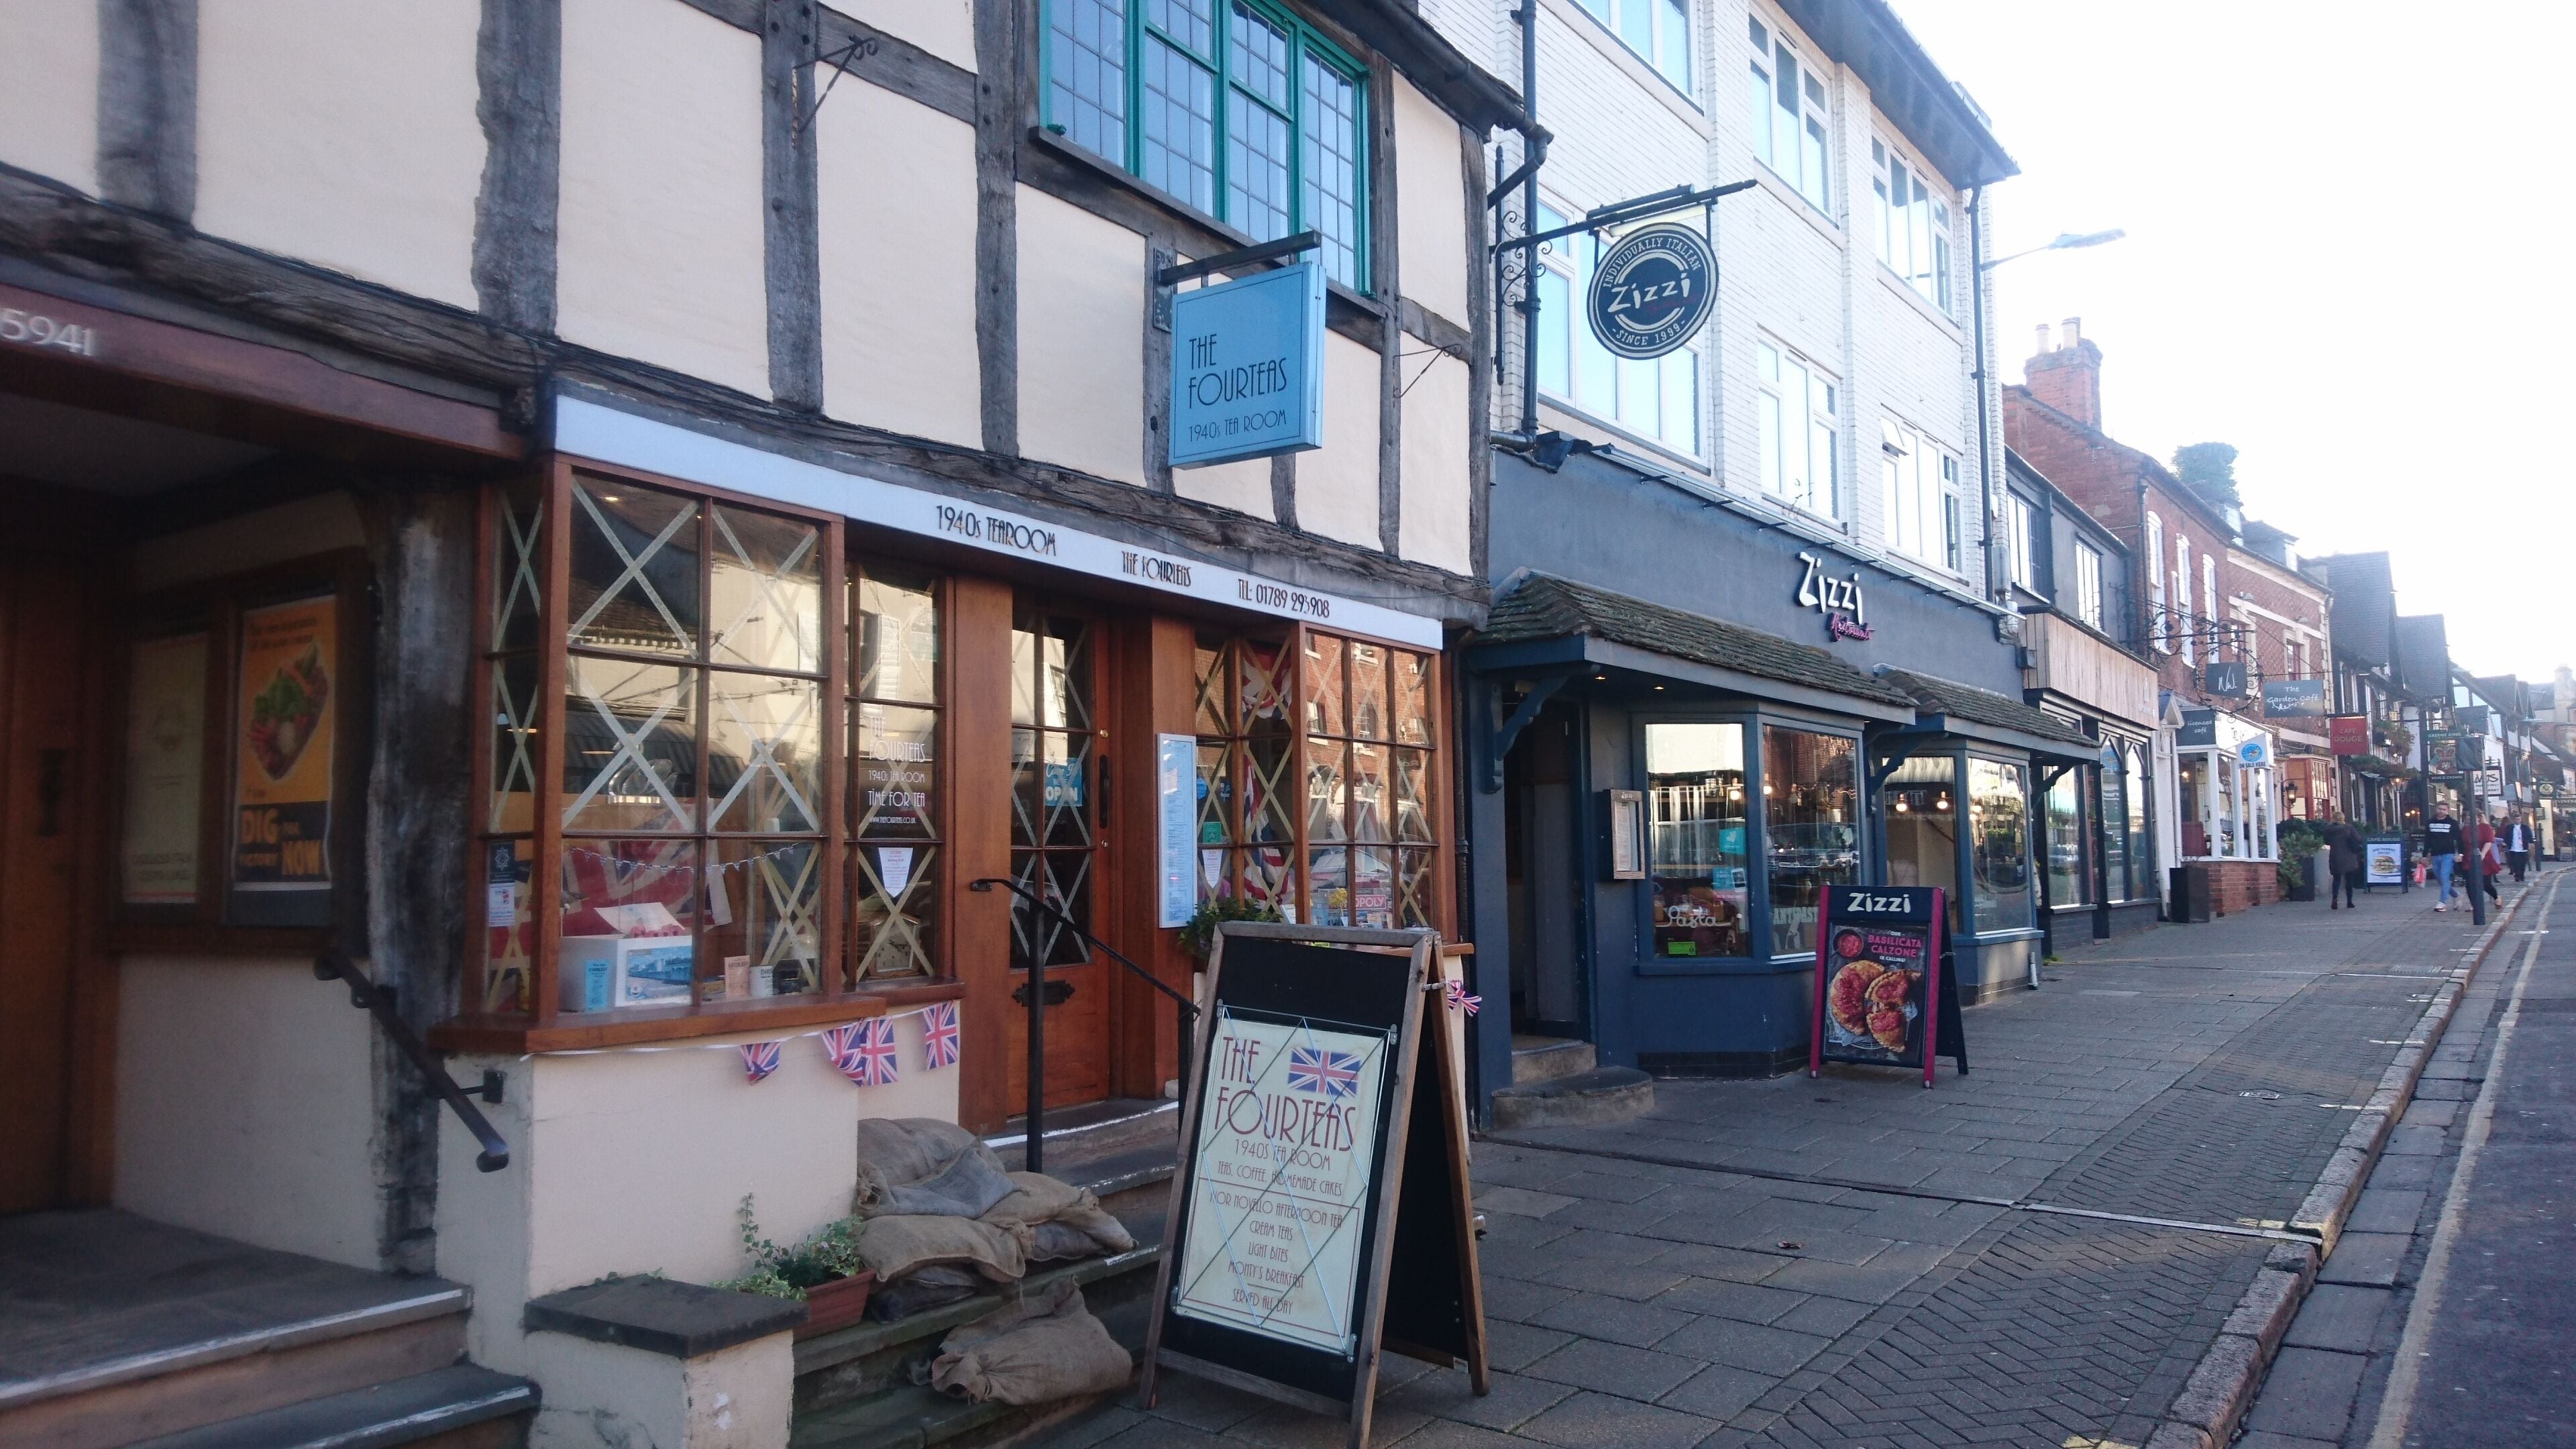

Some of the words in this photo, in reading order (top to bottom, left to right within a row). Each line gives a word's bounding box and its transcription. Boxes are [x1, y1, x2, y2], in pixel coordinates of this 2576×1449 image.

[1603, 237, 1663, 287] INDIVIDUALLY
[1666, 238, 1701, 270] ITALIAN
[1607, 272, 1690, 313] Zizzi
[1616, 330, 1648, 345] SINCE
[1656, 324, 1680, 343] 1999
[1189, 333, 1217, 370] THE
[1188, 358, 1287, 409] FOURTEAS
[1189, 422, 1220, 442] 1940s
[1224, 417, 1238, 435] TEA
[1243, 410, 1286, 432] ROOM
[936, 504, 981, 538] 1940s
[986, 517, 1057, 557] TEAROOM
[1122, 551, 1138, 576] THE
[1142, 556, 1191, 587] FOURTEAS
[1256, 584, 1288, 608] 01789
[1799, 551, 1863, 625] Zizzi
[2267, 695, 2298, 703] Garden
[869, 717, 885, 737] THE
[869, 741, 926, 762] FOURTEAS
[901, 772, 925, 783] ROOM
[889, 792, 910, 807] FOR
[912, 792, 925, 807] TEA
[1046, 786, 1077, 801] OPN
[241, 808, 280, 845] DIG
[282, 840, 321, 875] NOW
[1847, 892, 1911, 914] Zizzi
[1868, 934, 1922, 948] BASILICATA
[1871, 945, 1917, 957] CALZONE
[1222, 1037, 1260, 1084] THE
[1215, 1087, 1356, 1151] FOURTEAS
[1236, 1139, 1269, 1159] 1940S
[1273, 1145, 1287, 1163] TEA
[1290, 1148, 1330, 1171] ROOM
[1272, 1171, 1317, 1191] HOMEMADE
[1320, 1181, 1342, 1196] CAKES
[1234, 1195, 1273, 1214] NOVELLO
[1276, 1203, 1327, 1225] AFTERNOON
[1330, 1214, 1342, 1228] TEA
[1250, 1220, 1275, 1237] CREAM
[1278, 1225, 1293, 1240] TEAS
[1248, 1242, 1267, 1258] LIGHT
[1270, 1246, 1289, 1263] BITES
[1228, 1260, 1263, 1279] MONTY'S
[1265, 1268, 1305, 1289] BREAKFAST
[1232, 1288, 1259, 1306] SERVED
[1263, 1295, 1274, 1309] ALL
[1276, 1298, 1293, 1315] DAY
